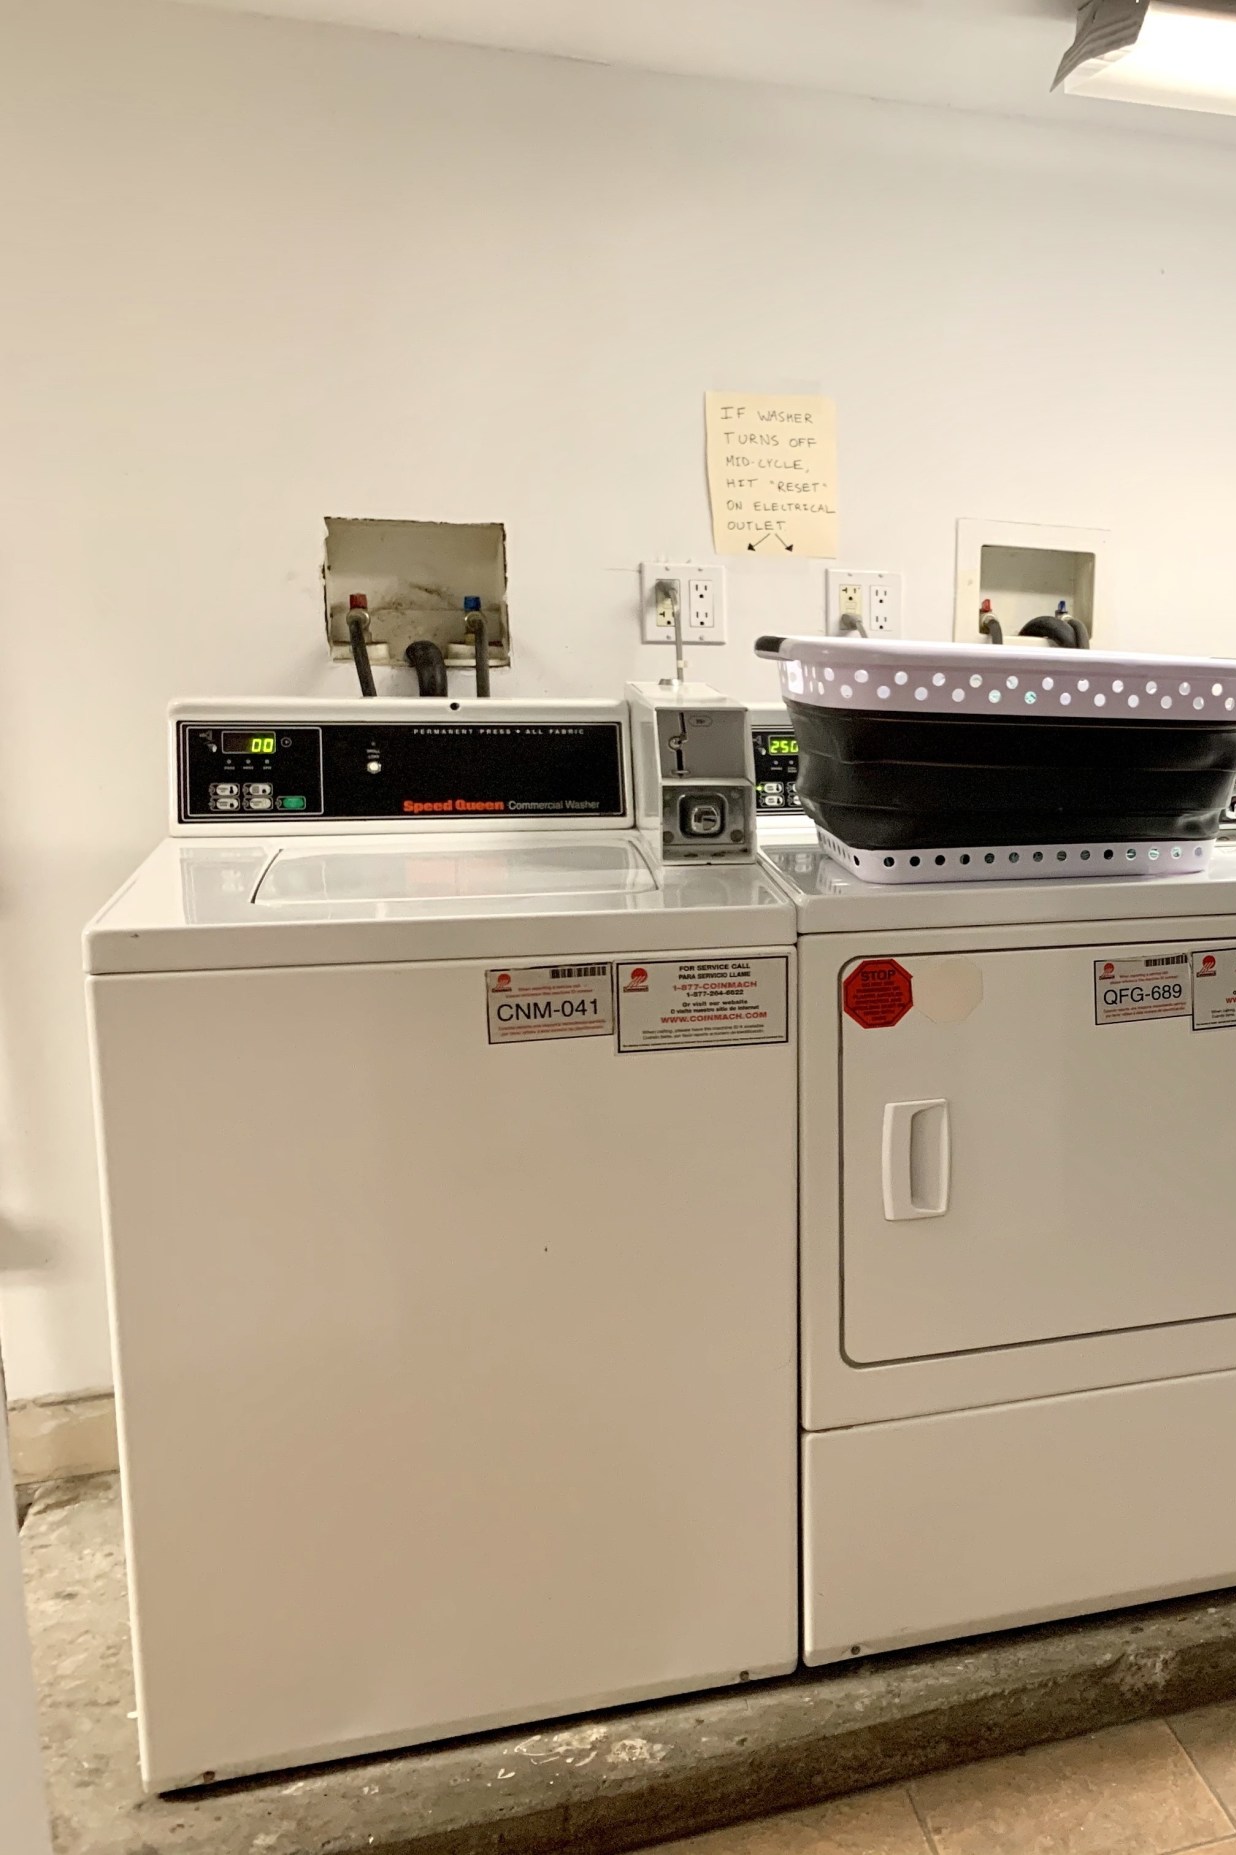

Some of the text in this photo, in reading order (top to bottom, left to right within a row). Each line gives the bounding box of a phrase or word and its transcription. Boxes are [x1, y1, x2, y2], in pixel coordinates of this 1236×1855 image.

[720, 407, 814, 424] IF WASHER
[724, 432, 817, 448] TURNS OFF
[726, 479, 758, 488] HIT
[727, 500, 836, 513] ON ELECTRICAL
[727, 521, 785, 530] OUTLET
[251, 738, 274, 753] 00
[403, 799, 600, 814] Speed Queen Commercial Washer
[860, 969, 896, 981] STOP
[673, 981, 757, 991] 1-877-COINMACH
[1103, 983, 1182, 1005] QFG-689
[497, 998, 597, 1022] CNM-041
[660, 1011, 768, 1024] WWW.COINMACH.COM
